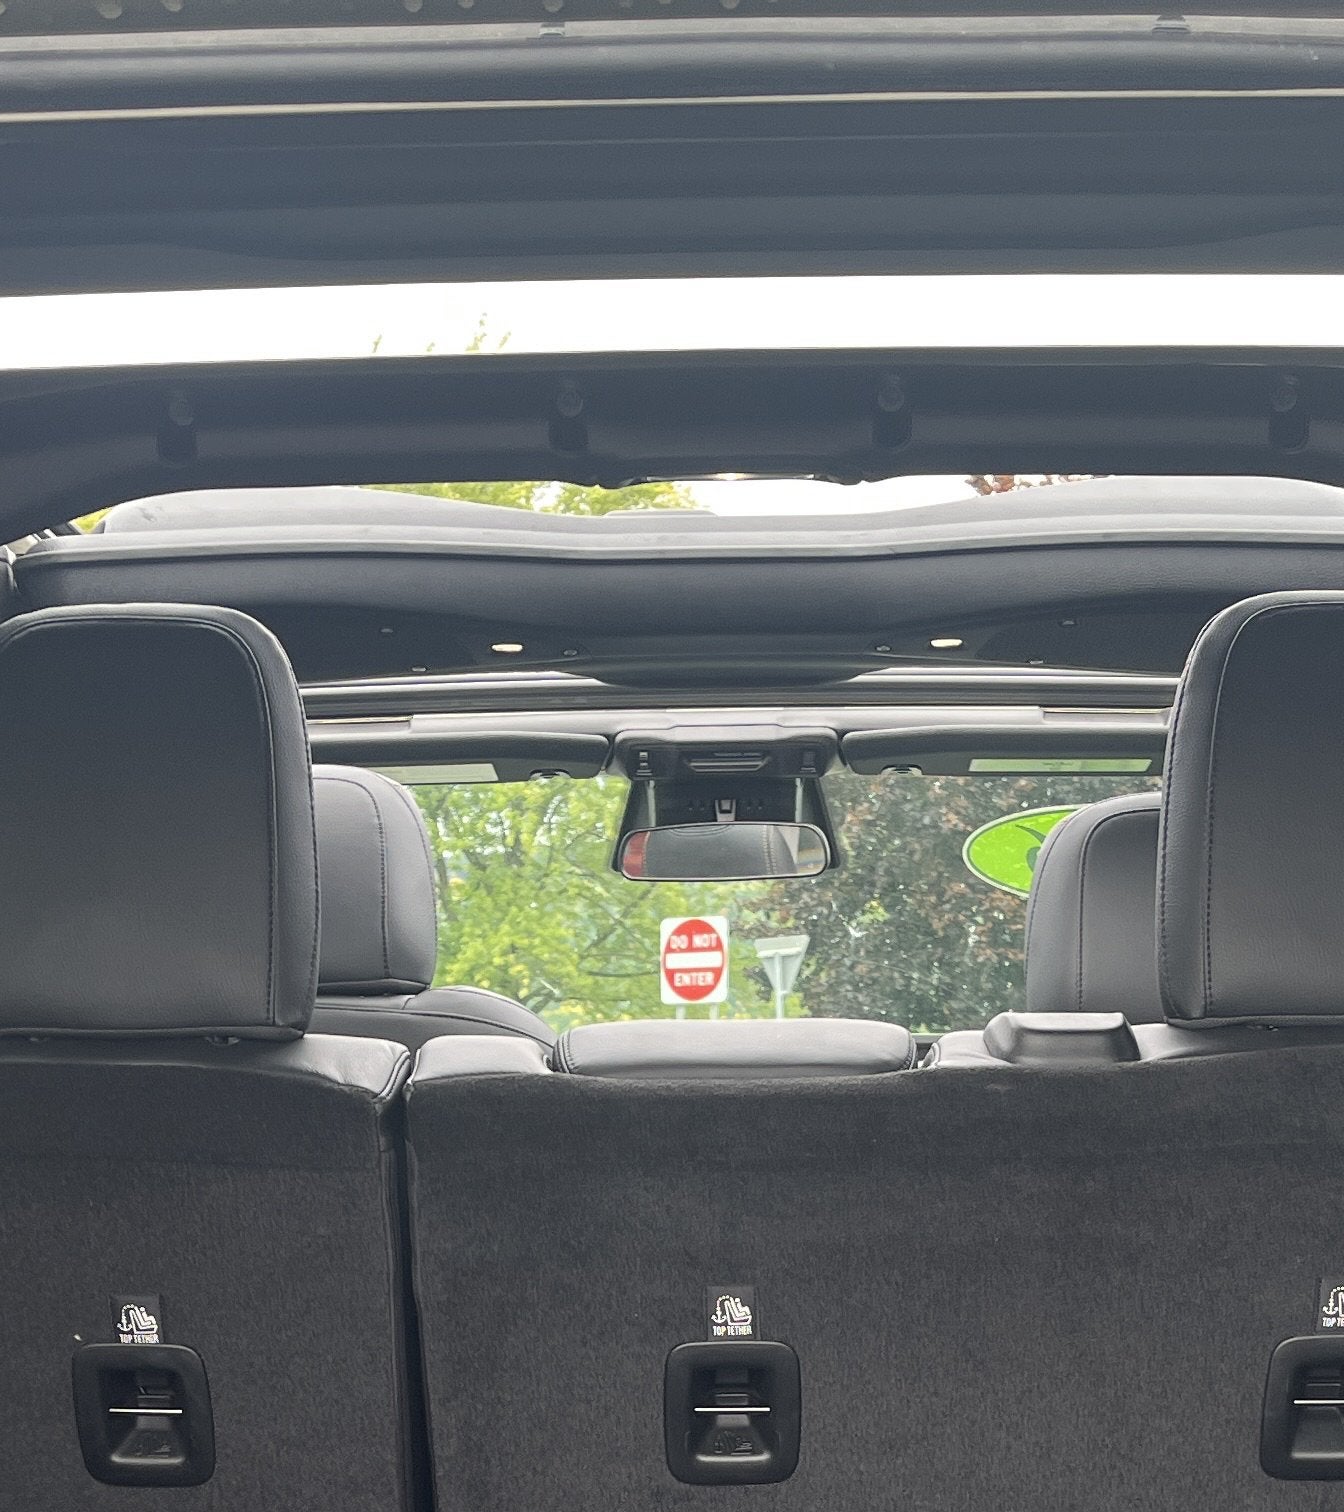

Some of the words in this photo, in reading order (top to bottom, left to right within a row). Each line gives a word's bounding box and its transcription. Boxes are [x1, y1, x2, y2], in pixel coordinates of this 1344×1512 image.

[670, 935, 688, 949] DO
[692, 934, 717, 948] NOT
[674, 972, 714, 987] ENTER
[1323, 1317, 1336, 1327] TOP
[713, 1325, 726, 1336] TOP
[727, 1325, 752, 1336] TETHER
[119, 1334, 133, 1343] TOP
